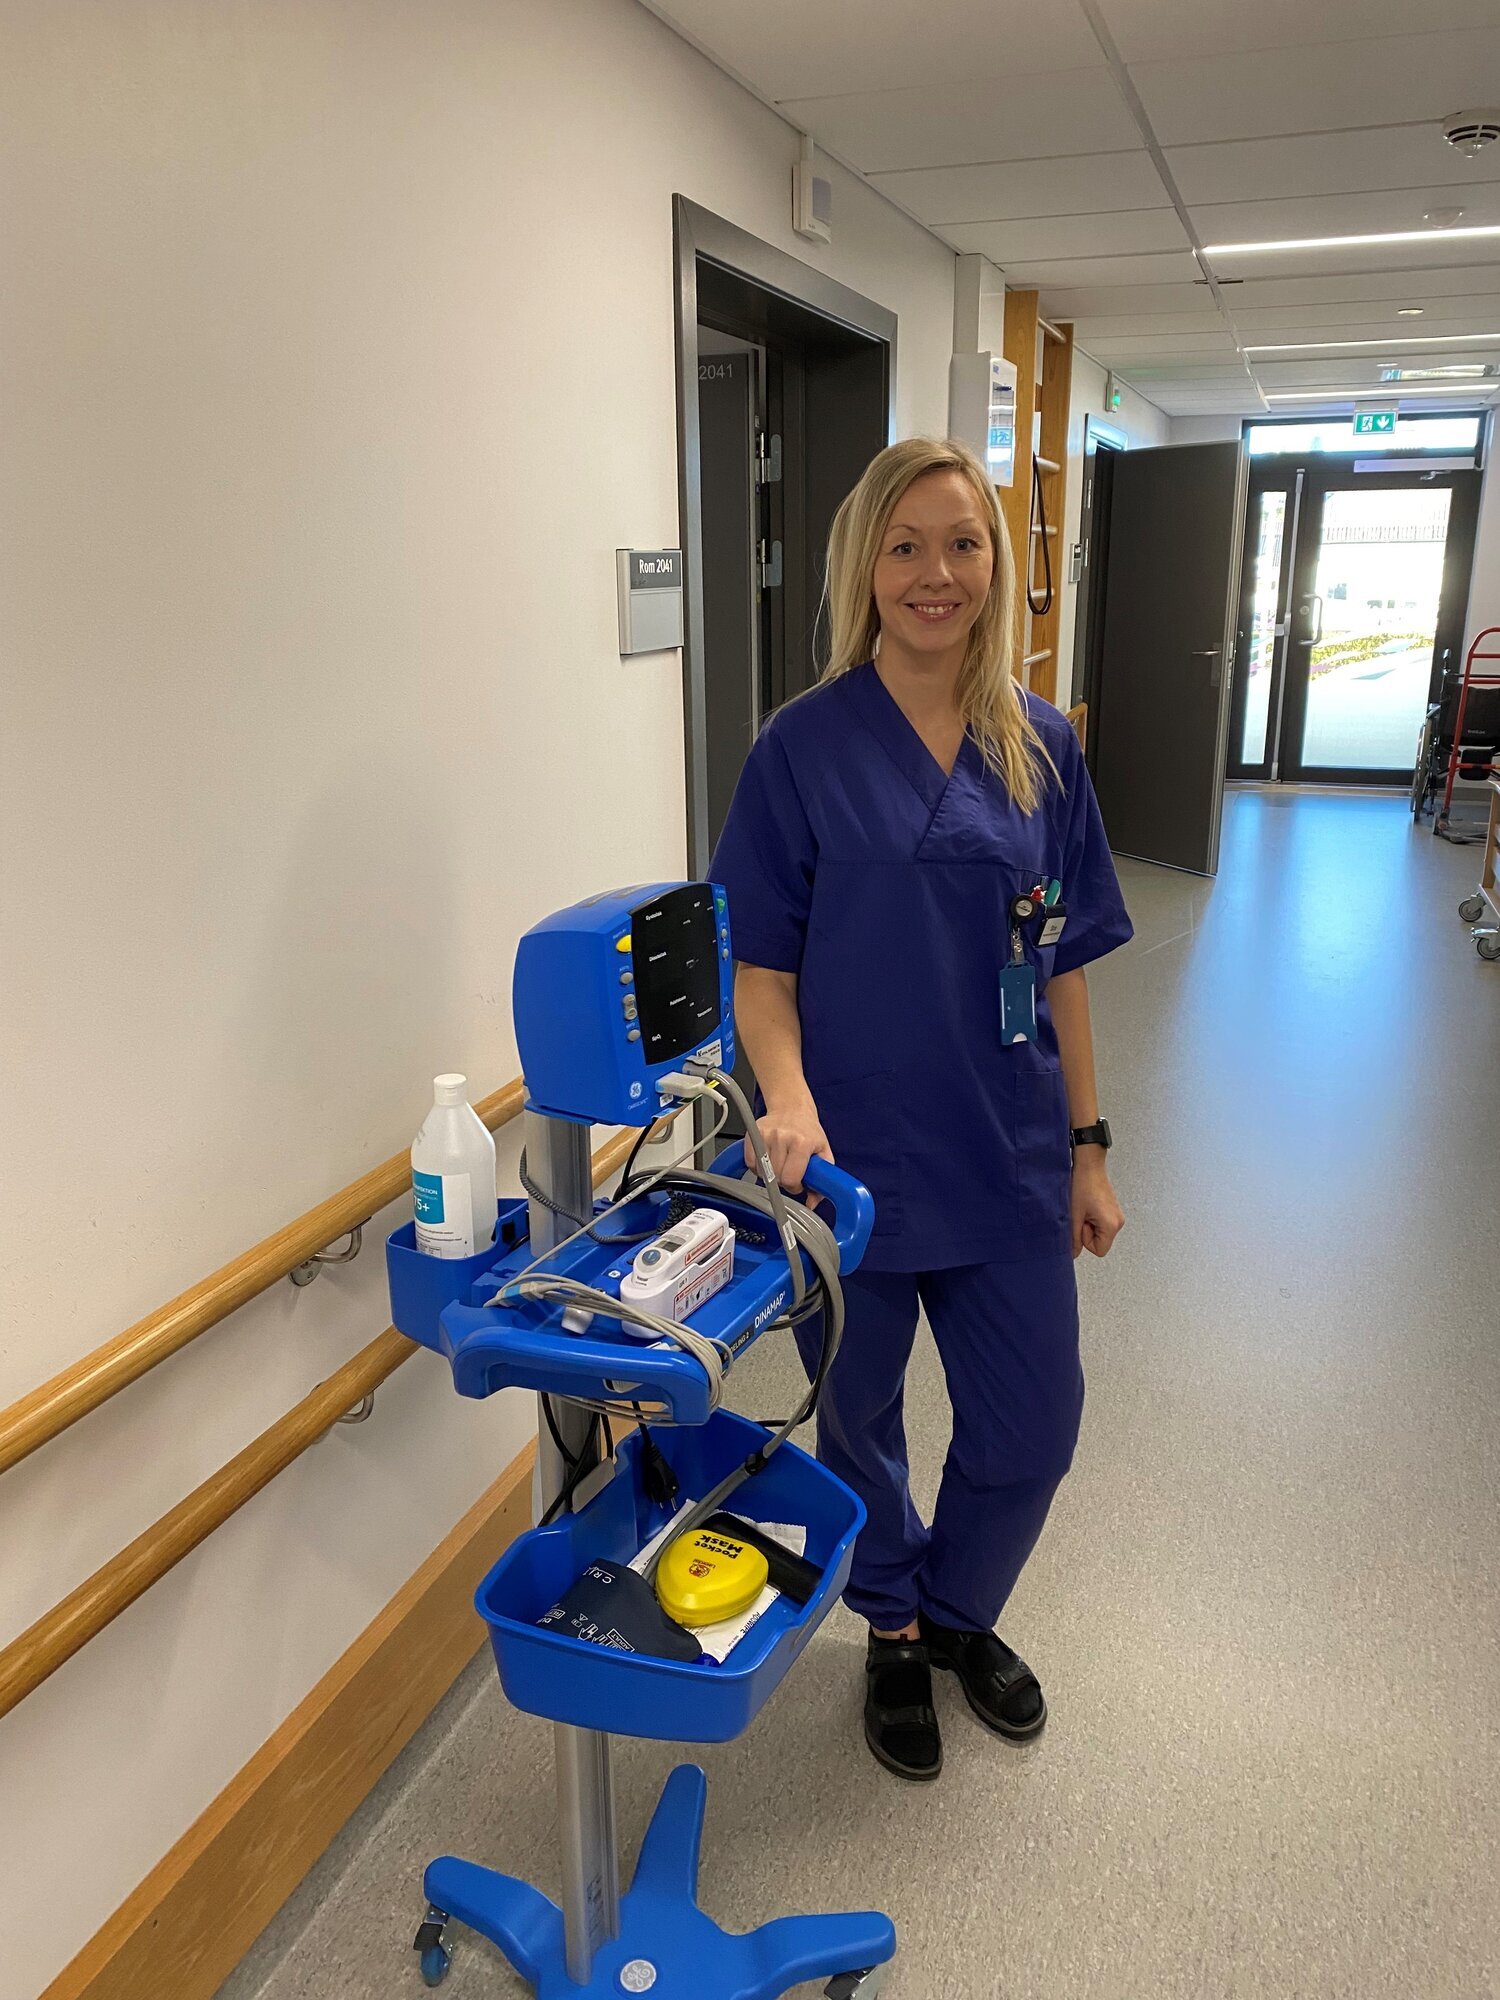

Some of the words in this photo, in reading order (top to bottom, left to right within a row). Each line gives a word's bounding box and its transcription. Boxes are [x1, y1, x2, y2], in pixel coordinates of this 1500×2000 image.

[698, 363, 733, 380] 2041
[639, 559, 656, 574] Rom
[656, 558, 673, 573] 2041
[754, 1292, 784, 1329] DINAMAP
[694, 1541, 738, 1559] Pocket
[699, 1534, 744, 1554] Mask
